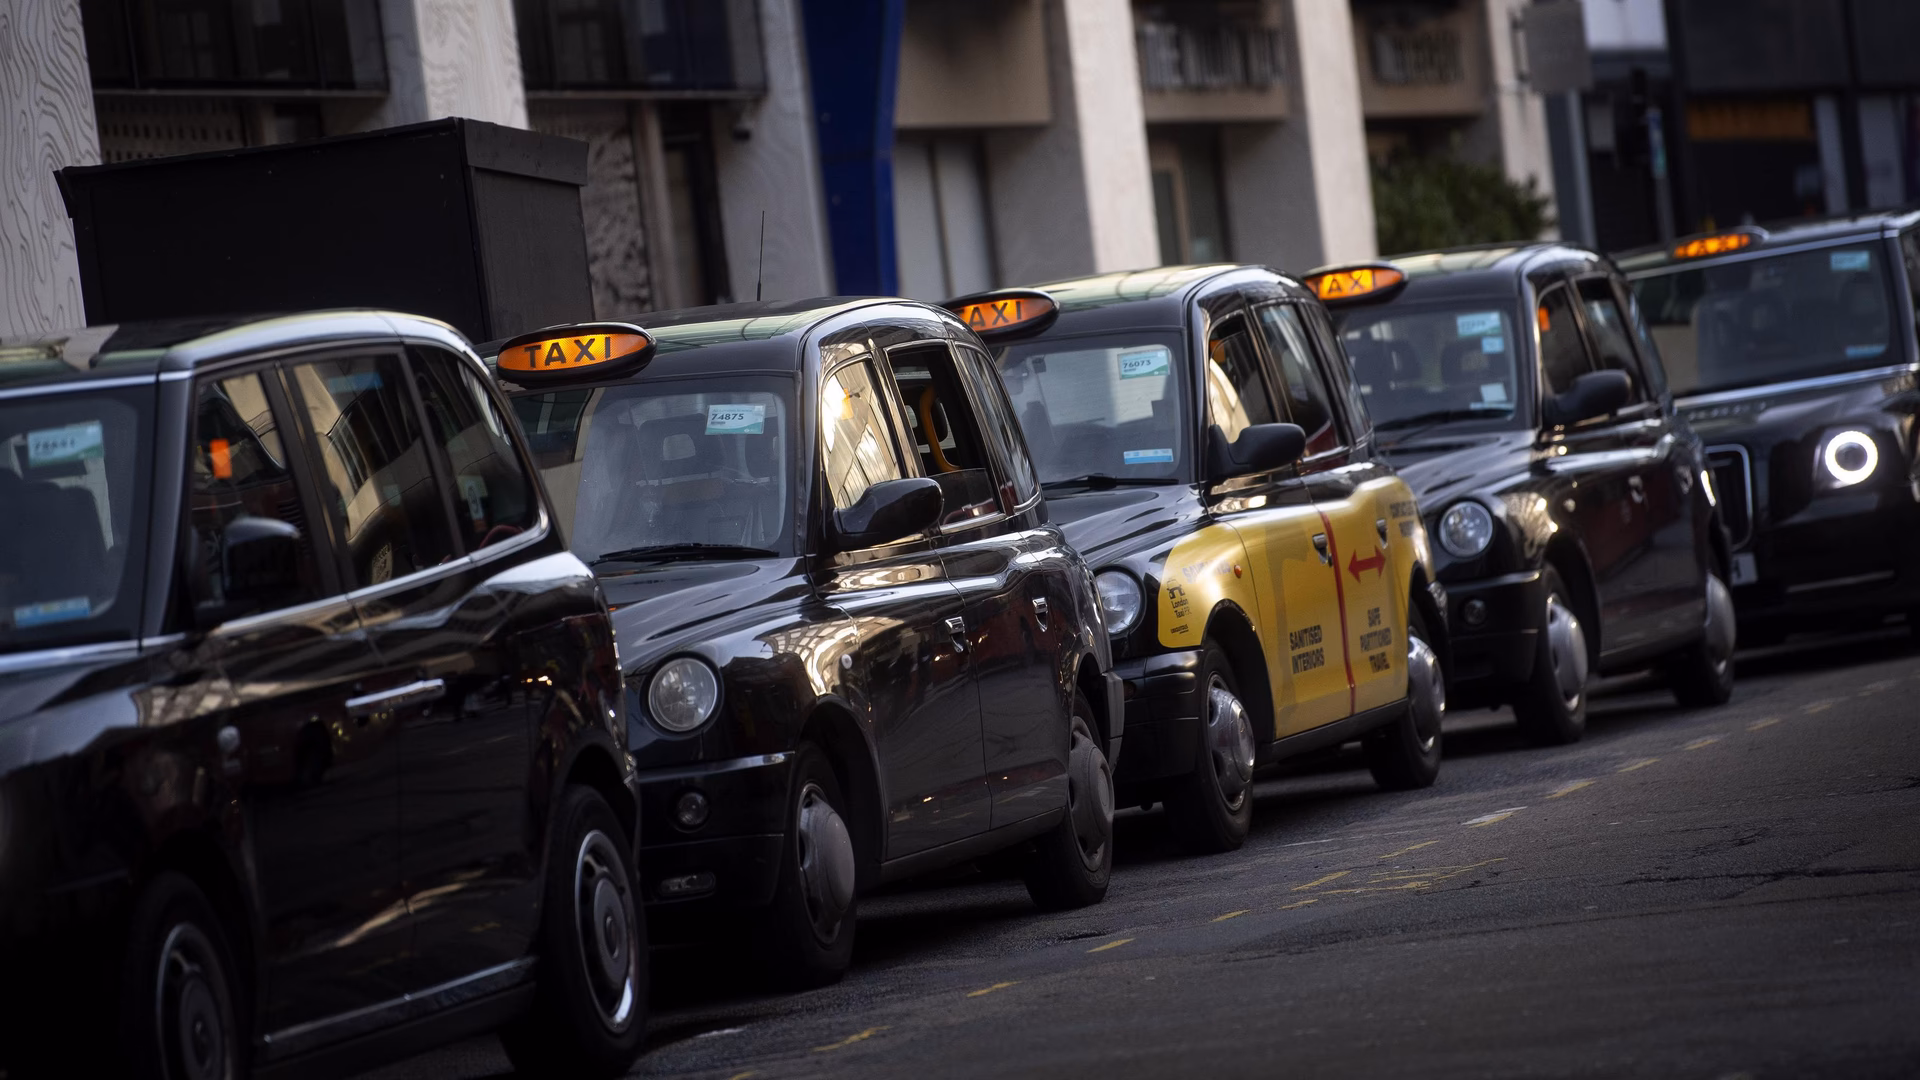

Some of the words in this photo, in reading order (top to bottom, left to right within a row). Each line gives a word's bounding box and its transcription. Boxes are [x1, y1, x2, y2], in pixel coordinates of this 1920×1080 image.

[960, 300, 1022, 326] AXI
[524, 336, 611, 369] TAXI
[1171, 599, 1188, 609] London
[1289, 624, 1322, 651] SANITISED
[1292, 647, 1325, 674] INTERIORS
